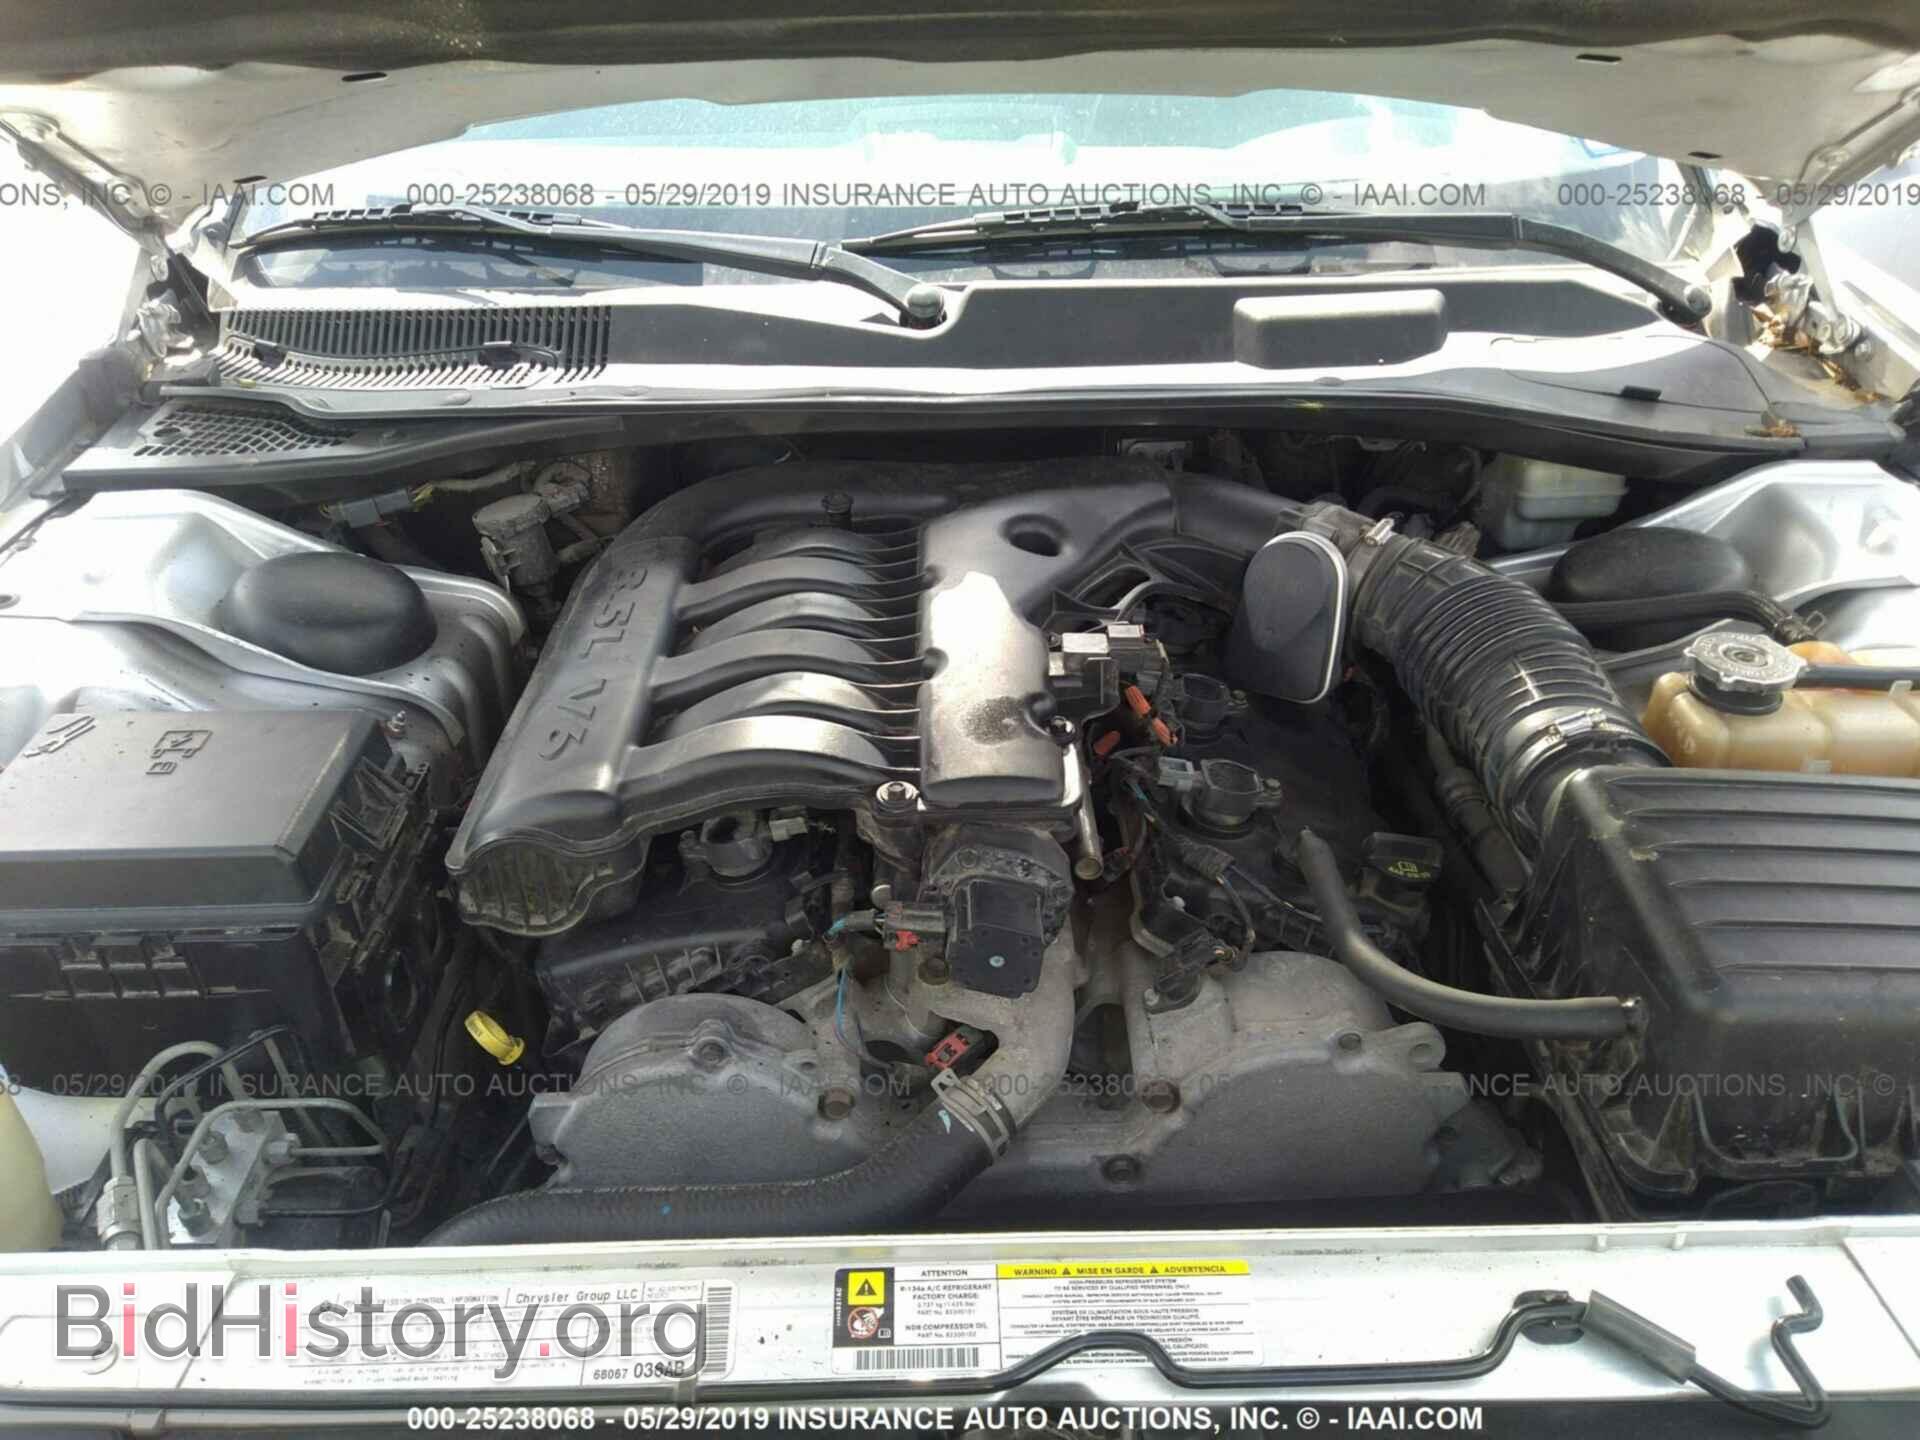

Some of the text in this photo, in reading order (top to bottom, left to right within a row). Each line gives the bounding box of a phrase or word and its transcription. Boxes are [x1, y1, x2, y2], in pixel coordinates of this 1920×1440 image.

[537, 678, 608, 762] V6
[921, 1269, 968, 1277] ATTENTION
[1014, 1265, 1226, 1276] WARNING MISE EN GARDE ADVERTENCIA
[515, 1292, 569, 1305] Chrysler
[576, 1291, 610, 1302] Group
[616, 1288, 639, 1300] LLC
[593, 1368, 628, 1380] 68067
